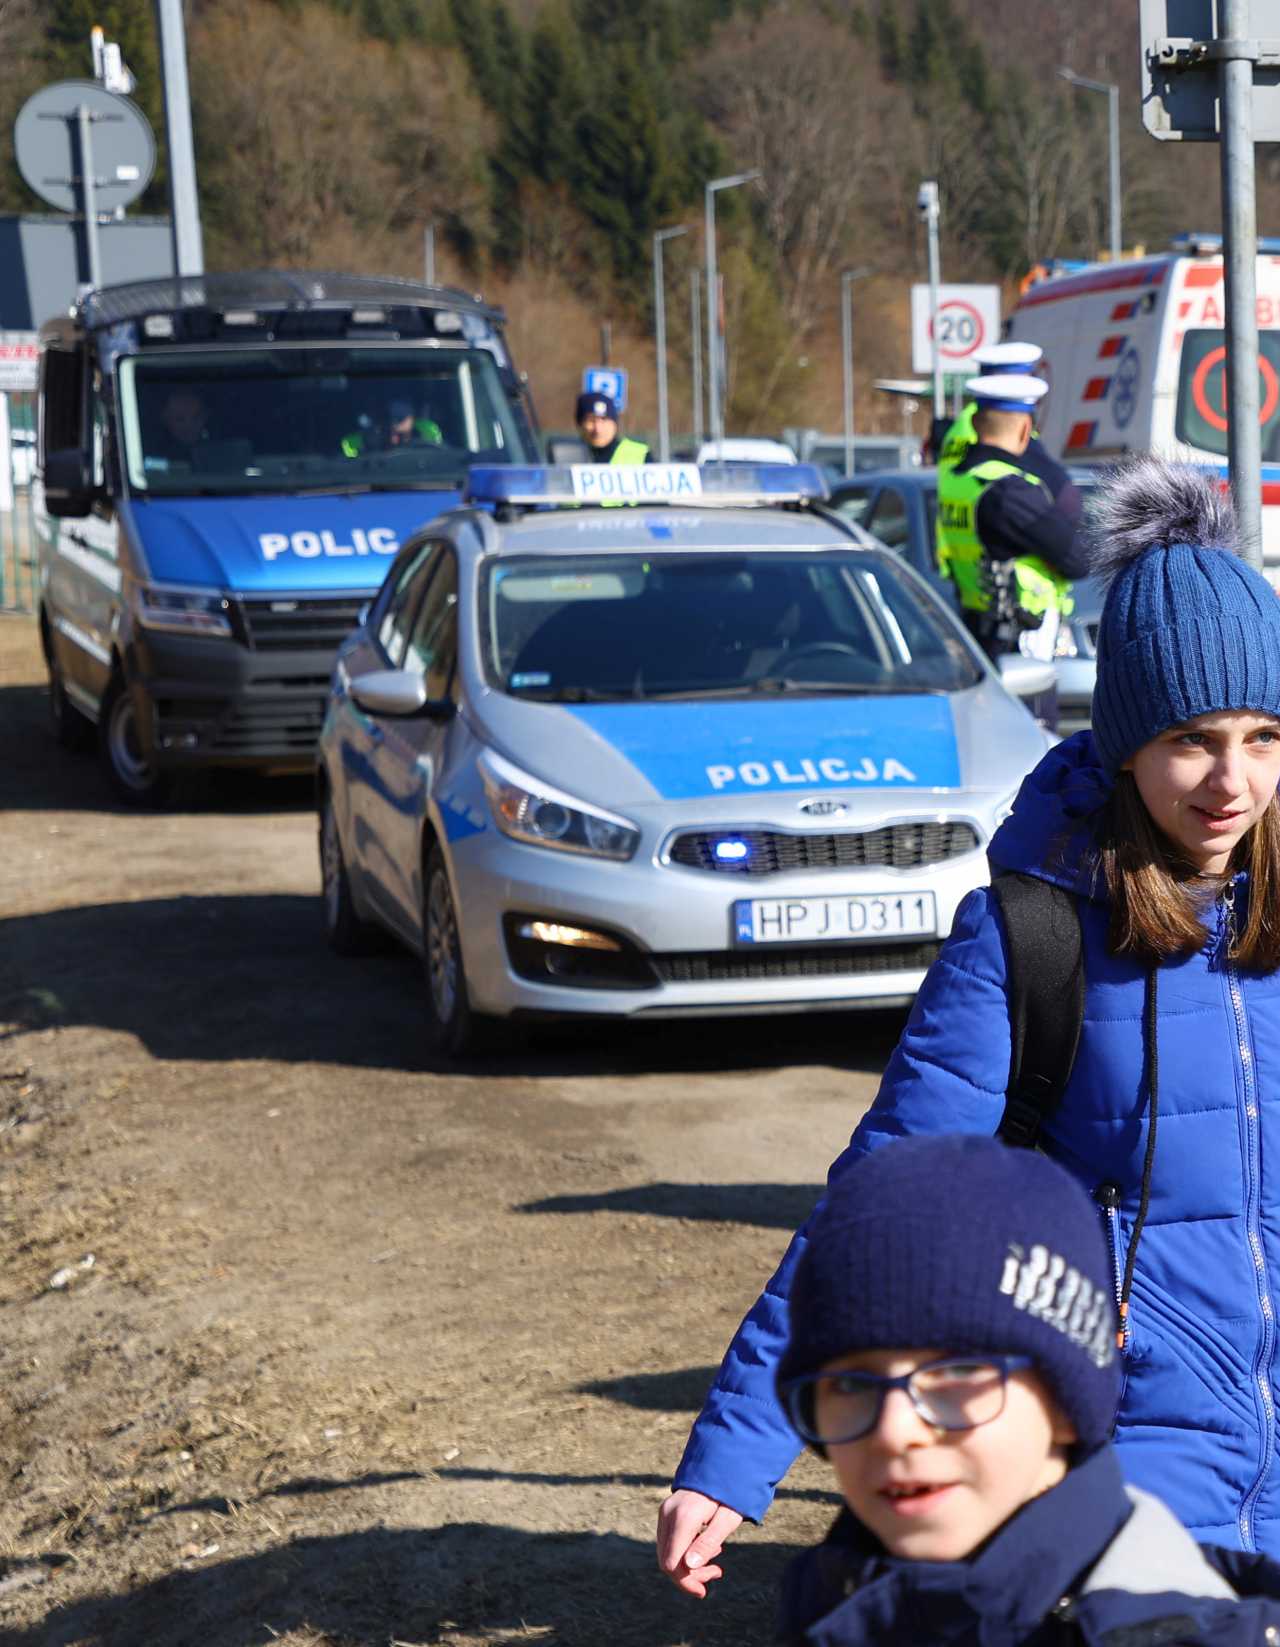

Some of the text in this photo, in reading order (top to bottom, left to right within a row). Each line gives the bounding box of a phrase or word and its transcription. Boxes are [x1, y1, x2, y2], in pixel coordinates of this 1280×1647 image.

[940, 316, 976, 342] 20
[580, 472, 693, 496] POLICJA
[706, 758, 917, 788] POLICJA
[848, 898, 926, 932] D311
